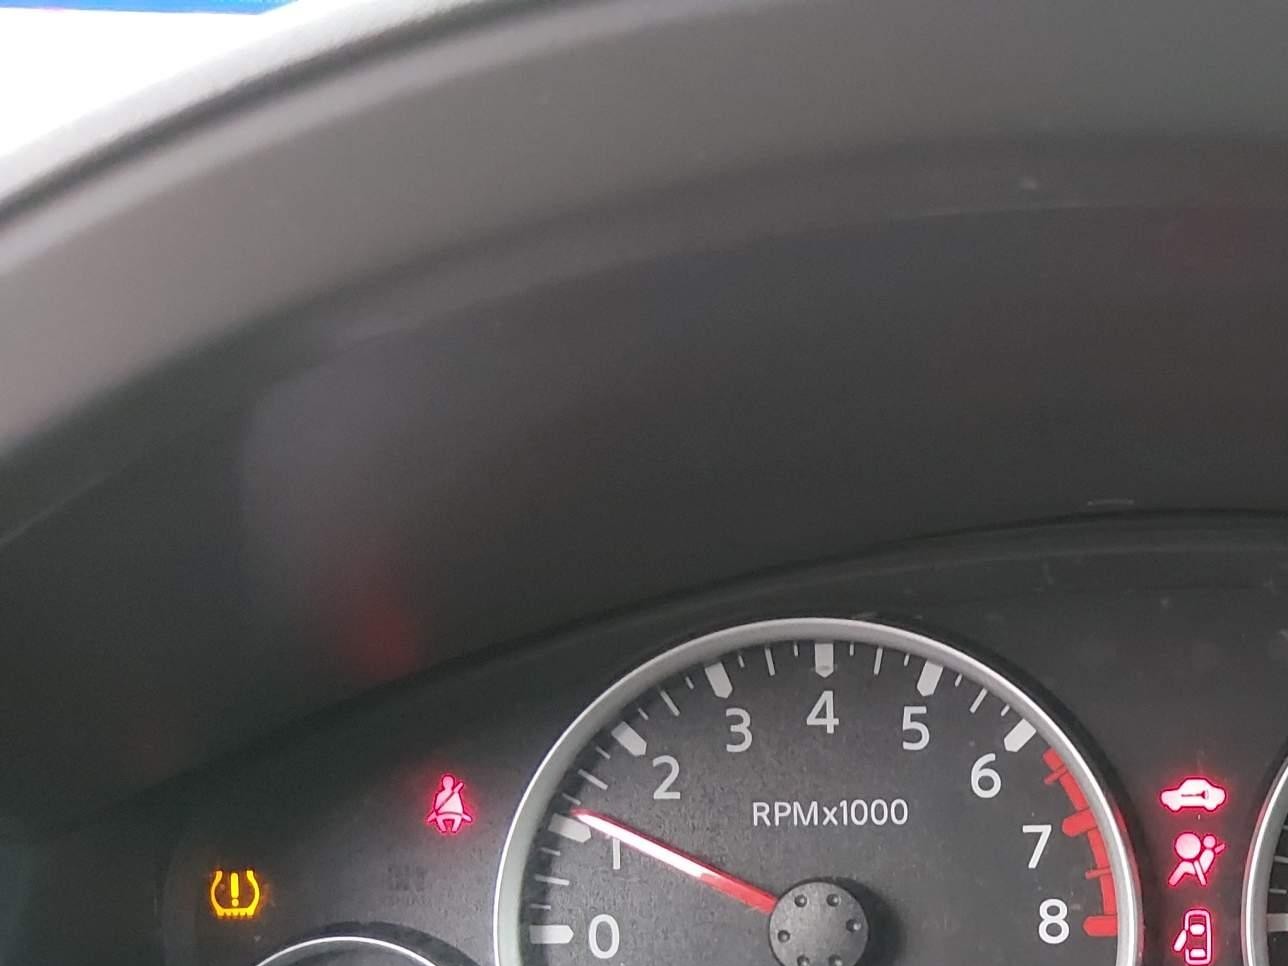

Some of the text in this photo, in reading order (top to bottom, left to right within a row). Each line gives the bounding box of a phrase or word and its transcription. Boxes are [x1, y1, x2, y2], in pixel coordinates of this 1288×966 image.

[726, 708, 752, 752] 3
[807, 691, 839, 734] 4
[903, 707, 929, 750] 5
[653, 756, 680, 799] 2
[971, 754, 1001, 798] 6
[753, 799, 907, 826] RPMx1000
[1023, 825, 1051, 868] 7
[589, 914, 619, 959] 0
[1039, 899, 1069, 944] 8
